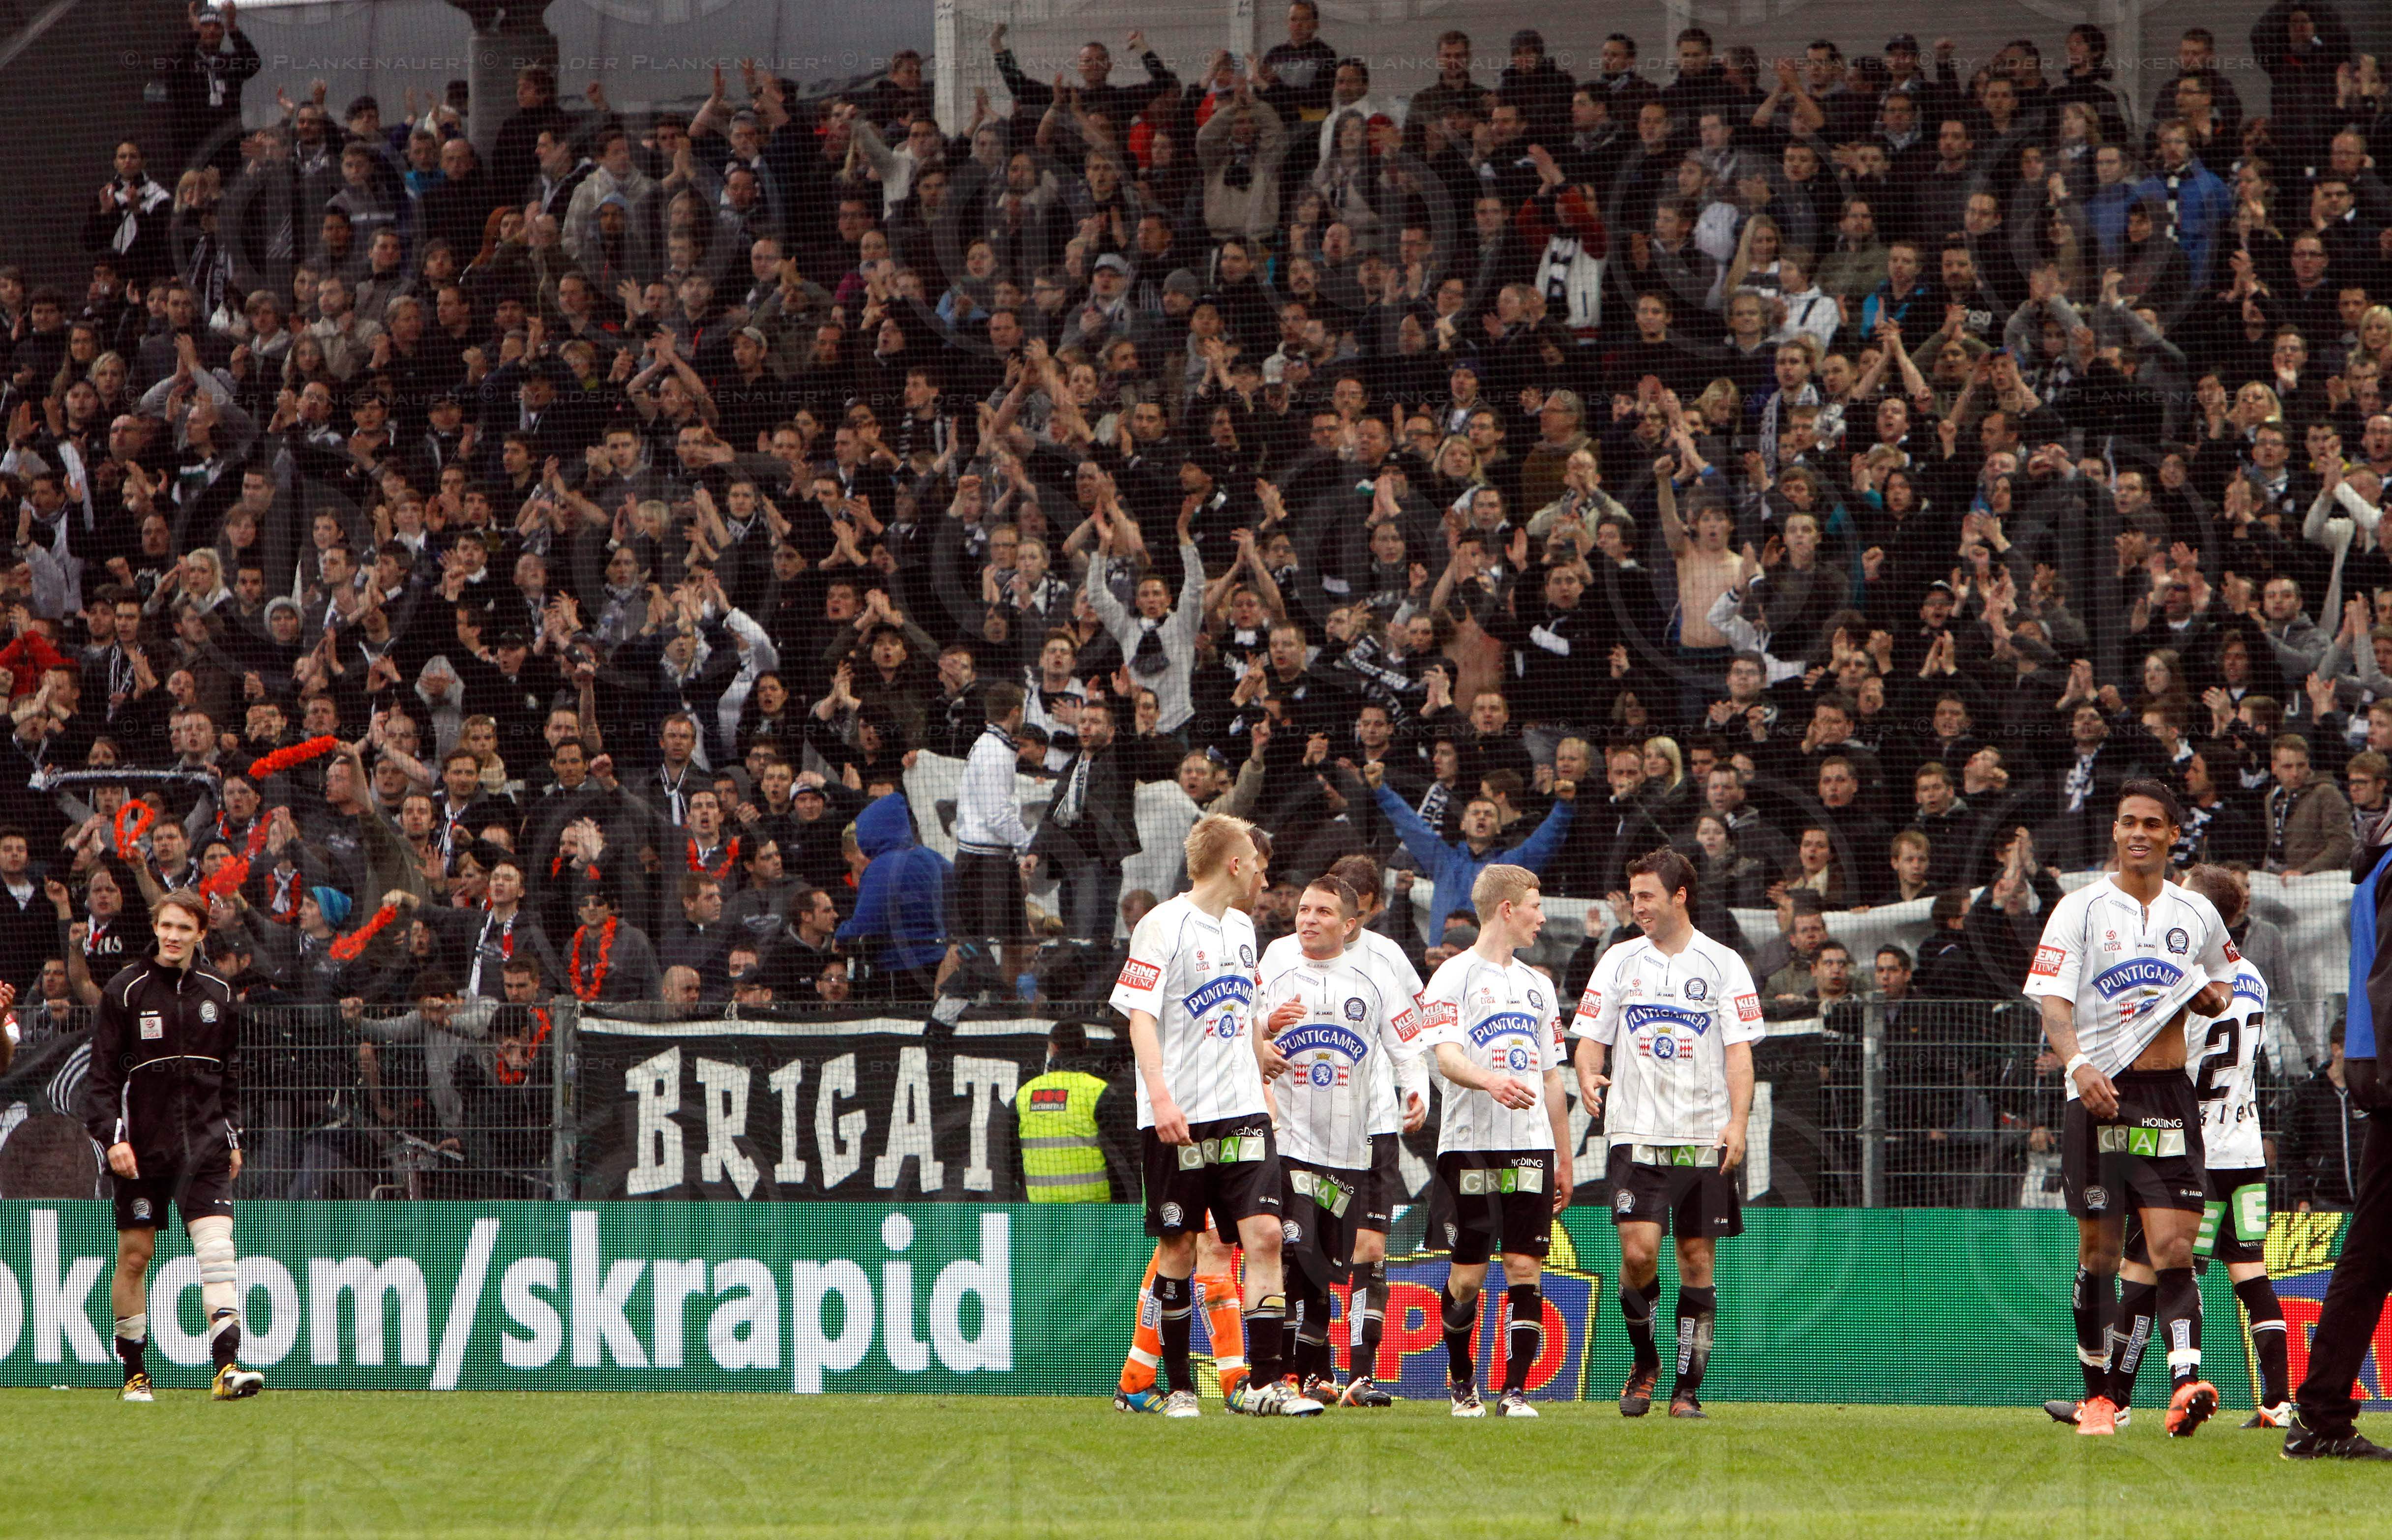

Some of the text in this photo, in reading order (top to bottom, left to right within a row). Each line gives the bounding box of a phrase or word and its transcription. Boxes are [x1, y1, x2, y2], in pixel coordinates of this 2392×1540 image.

[1189, 981, 1253, 1012] PUNTIGAME
[2232, 977, 2264, 1001] GAMER
[1423, 1003, 1457, 1017] KLEINE
[1280, 1030, 1363, 1058] PUNTIGAMER
[2197, 1011, 2264, 1102] 27
[1181, 1140, 1257, 1167] GRAZ
[1636, 1147, 1712, 1165] GRAZ
[1464, 1169, 1541, 1193] GRAZ
[1267, 1196, 1279, 1206] JAKO
[0, 1209, 1013, 1393] kcom/skrapid
[1351, 1294, 1365, 1343] PUNTIGAMER
[2123, 1319, 2148, 1371] PUNTIGAMER
